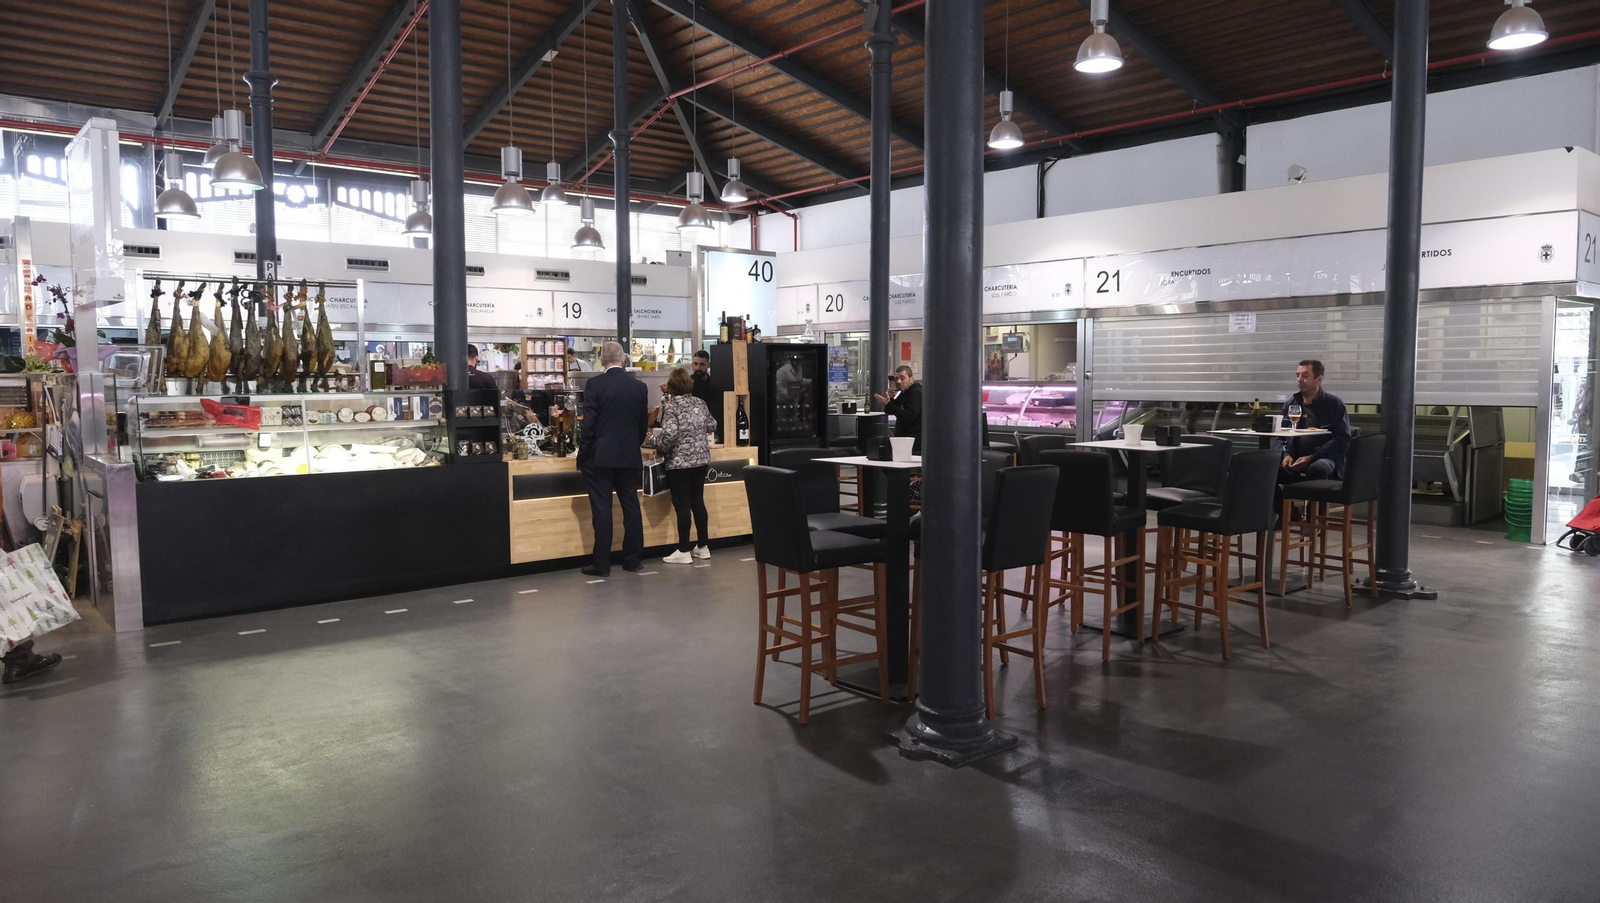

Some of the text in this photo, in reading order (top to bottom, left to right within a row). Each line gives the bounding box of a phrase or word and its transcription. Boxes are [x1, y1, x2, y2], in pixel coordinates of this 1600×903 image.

[1421, 248, 1452, 258] RTIDOS
[1584, 232, 1597, 265] 21
[747, 259, 774, 283] 40
[1170, 268, 1211, 278] ENCURTIDOS
[983, 283, 1017, 292] CHARCUTERÍA
[1096, 269, 1121, 294] 21
[562, 302, 582, 319] 19
[825, 293, 844, 313] 20
